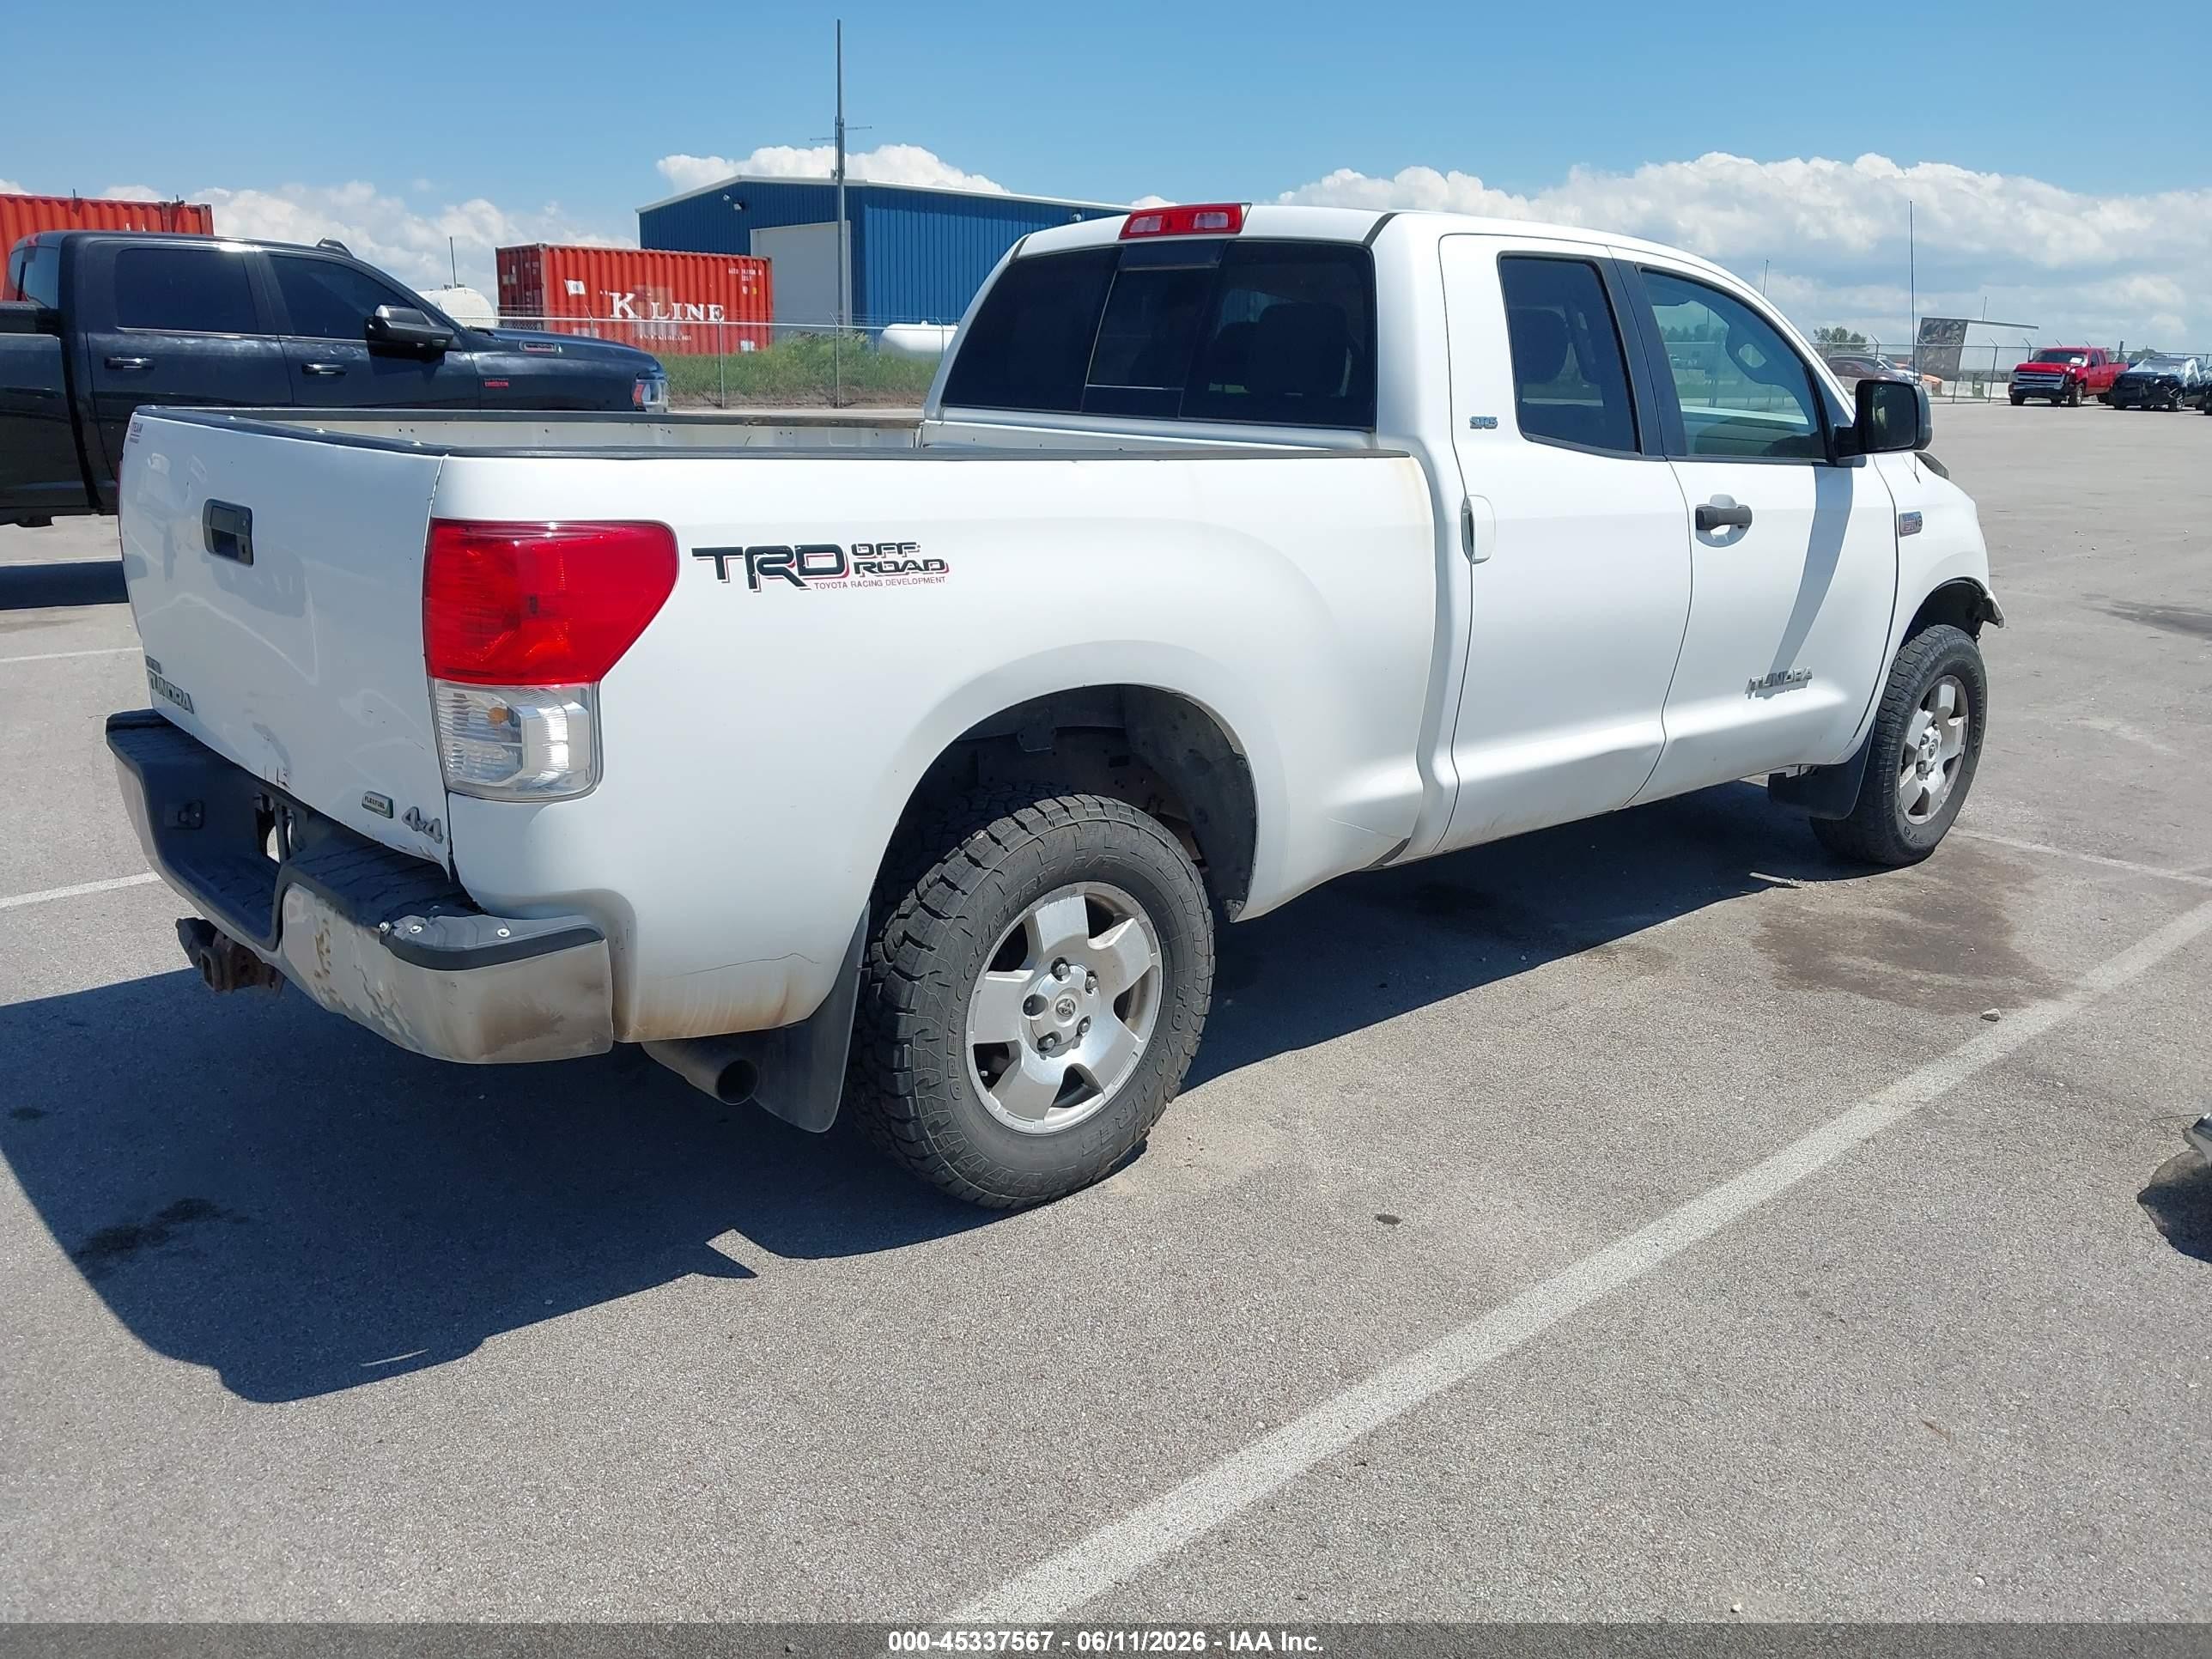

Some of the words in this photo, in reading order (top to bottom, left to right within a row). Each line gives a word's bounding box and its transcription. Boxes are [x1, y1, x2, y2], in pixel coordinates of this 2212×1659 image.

[651, 302, 725, 322] LINE
[691, 544, 848, 592] TRD
[851, 542, 921, 559] OFF
[853, 559, 949, 576] ROAD
[885, 576, 945, 586] DEVELOPMENT
